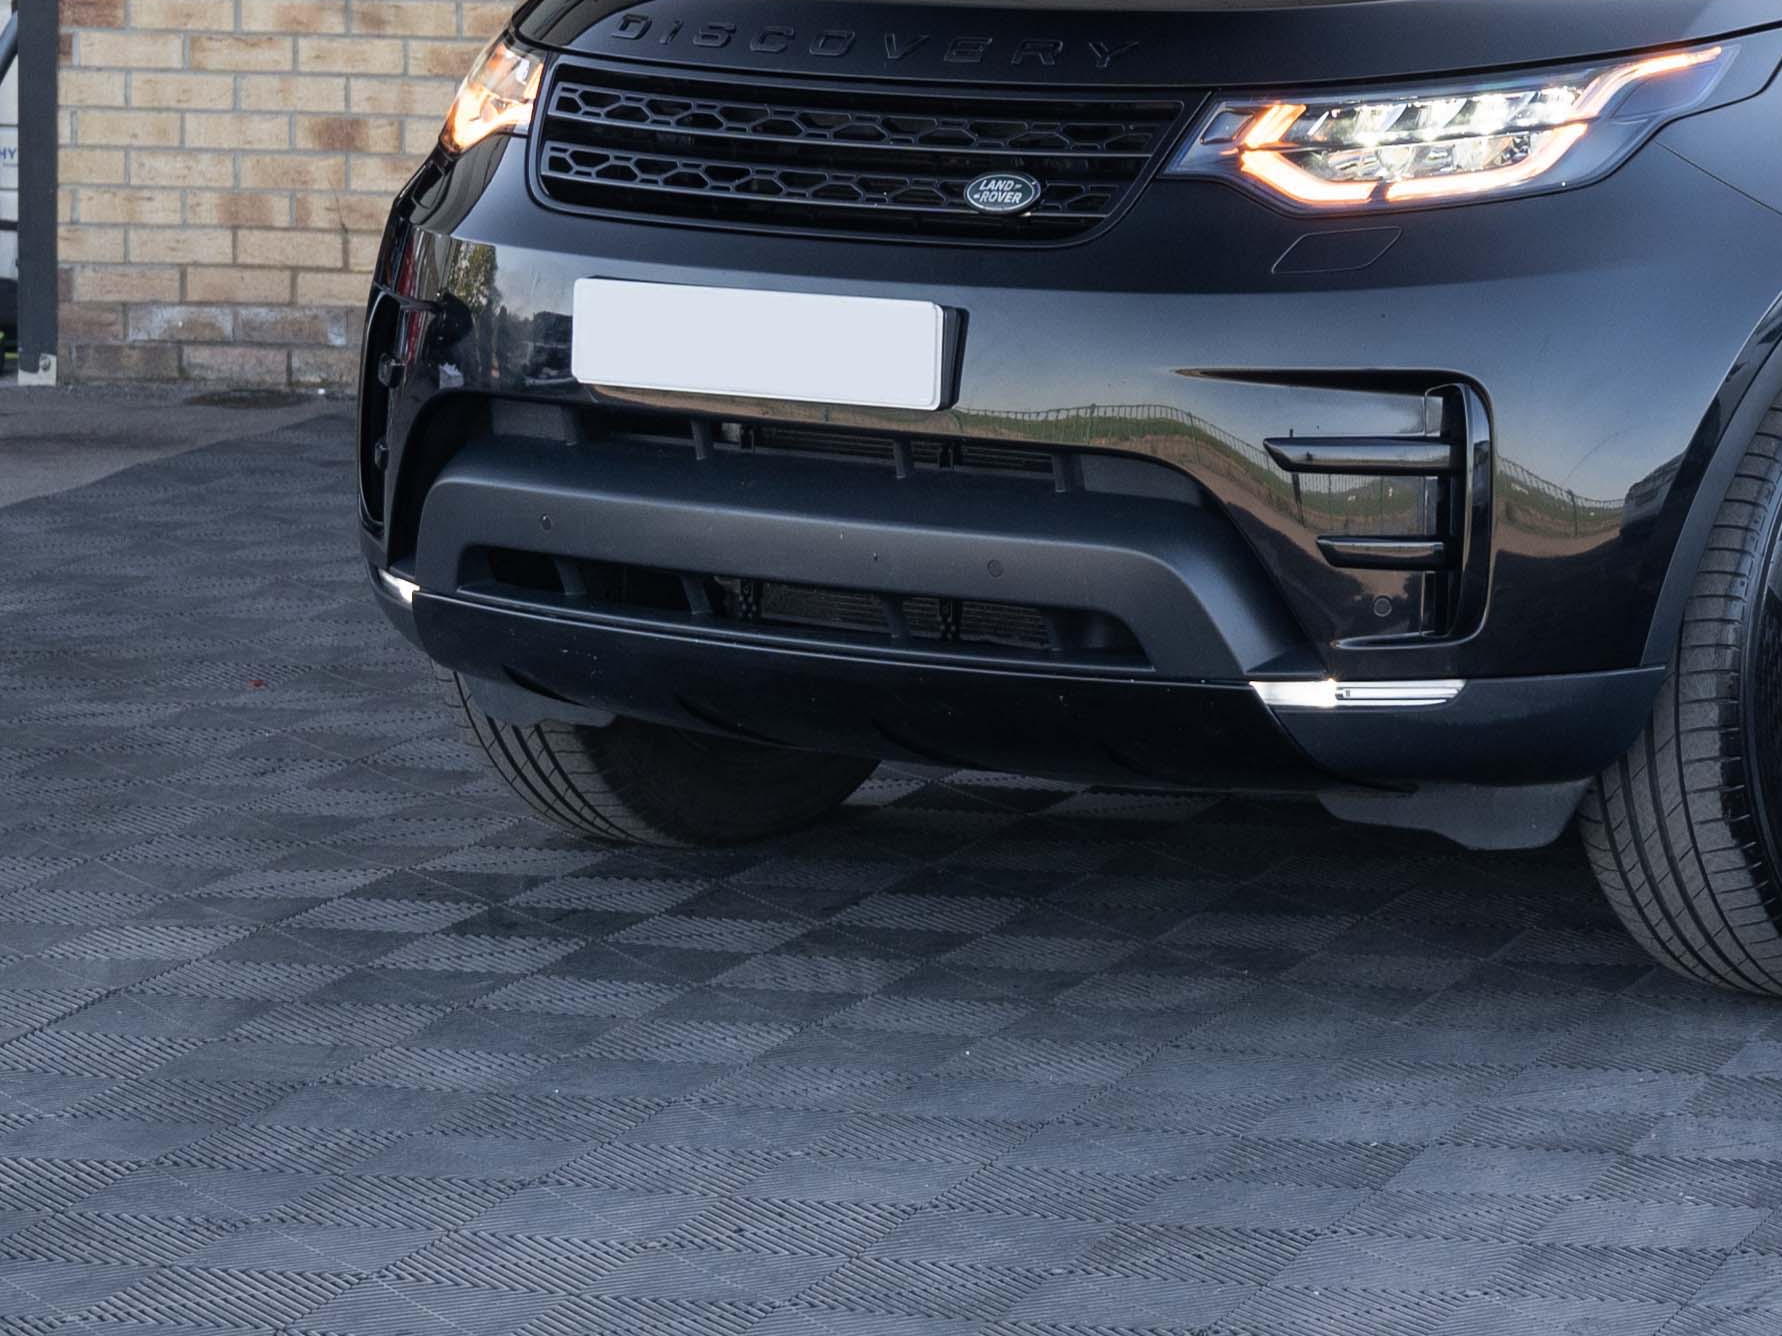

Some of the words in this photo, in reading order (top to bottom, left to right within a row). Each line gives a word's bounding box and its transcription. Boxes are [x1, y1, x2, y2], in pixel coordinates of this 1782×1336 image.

[611, 14, 1140, 68] DISCOVERY
[979, 179, 1015, 191] LAND
[979, 191, 1022, 204] ROVER
